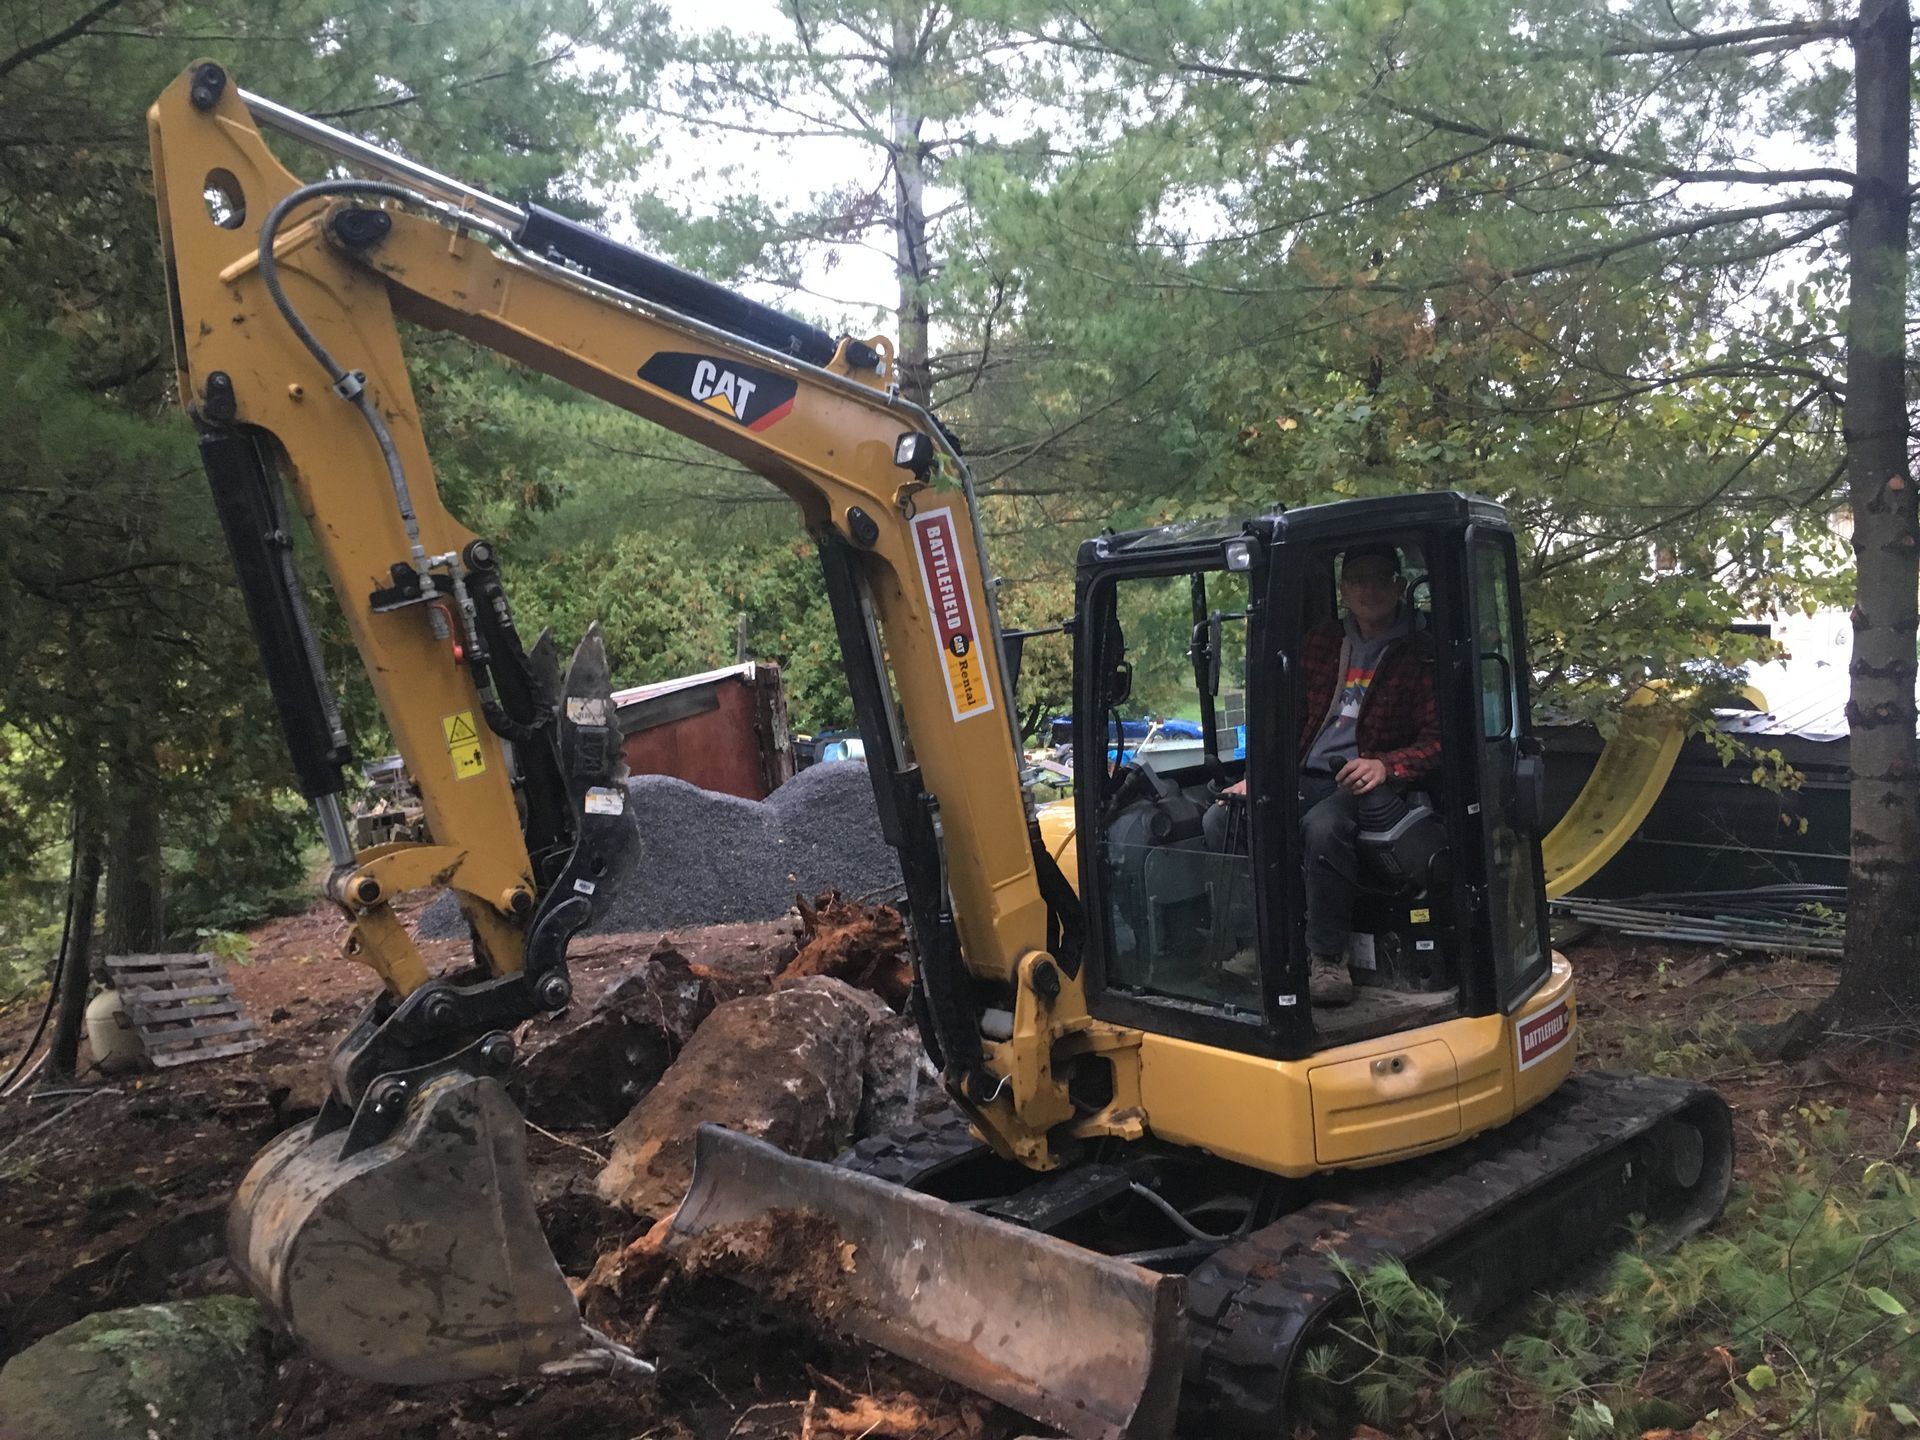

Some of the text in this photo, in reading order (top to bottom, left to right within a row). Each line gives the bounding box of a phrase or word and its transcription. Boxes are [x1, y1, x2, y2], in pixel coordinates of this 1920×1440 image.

[691, 360, 756, 420] CAT
[926, 525, 976, 706] BATTLEFIELD CAT Rental
[1524, 1014, 1563, 1051] BATTLEFIELD
